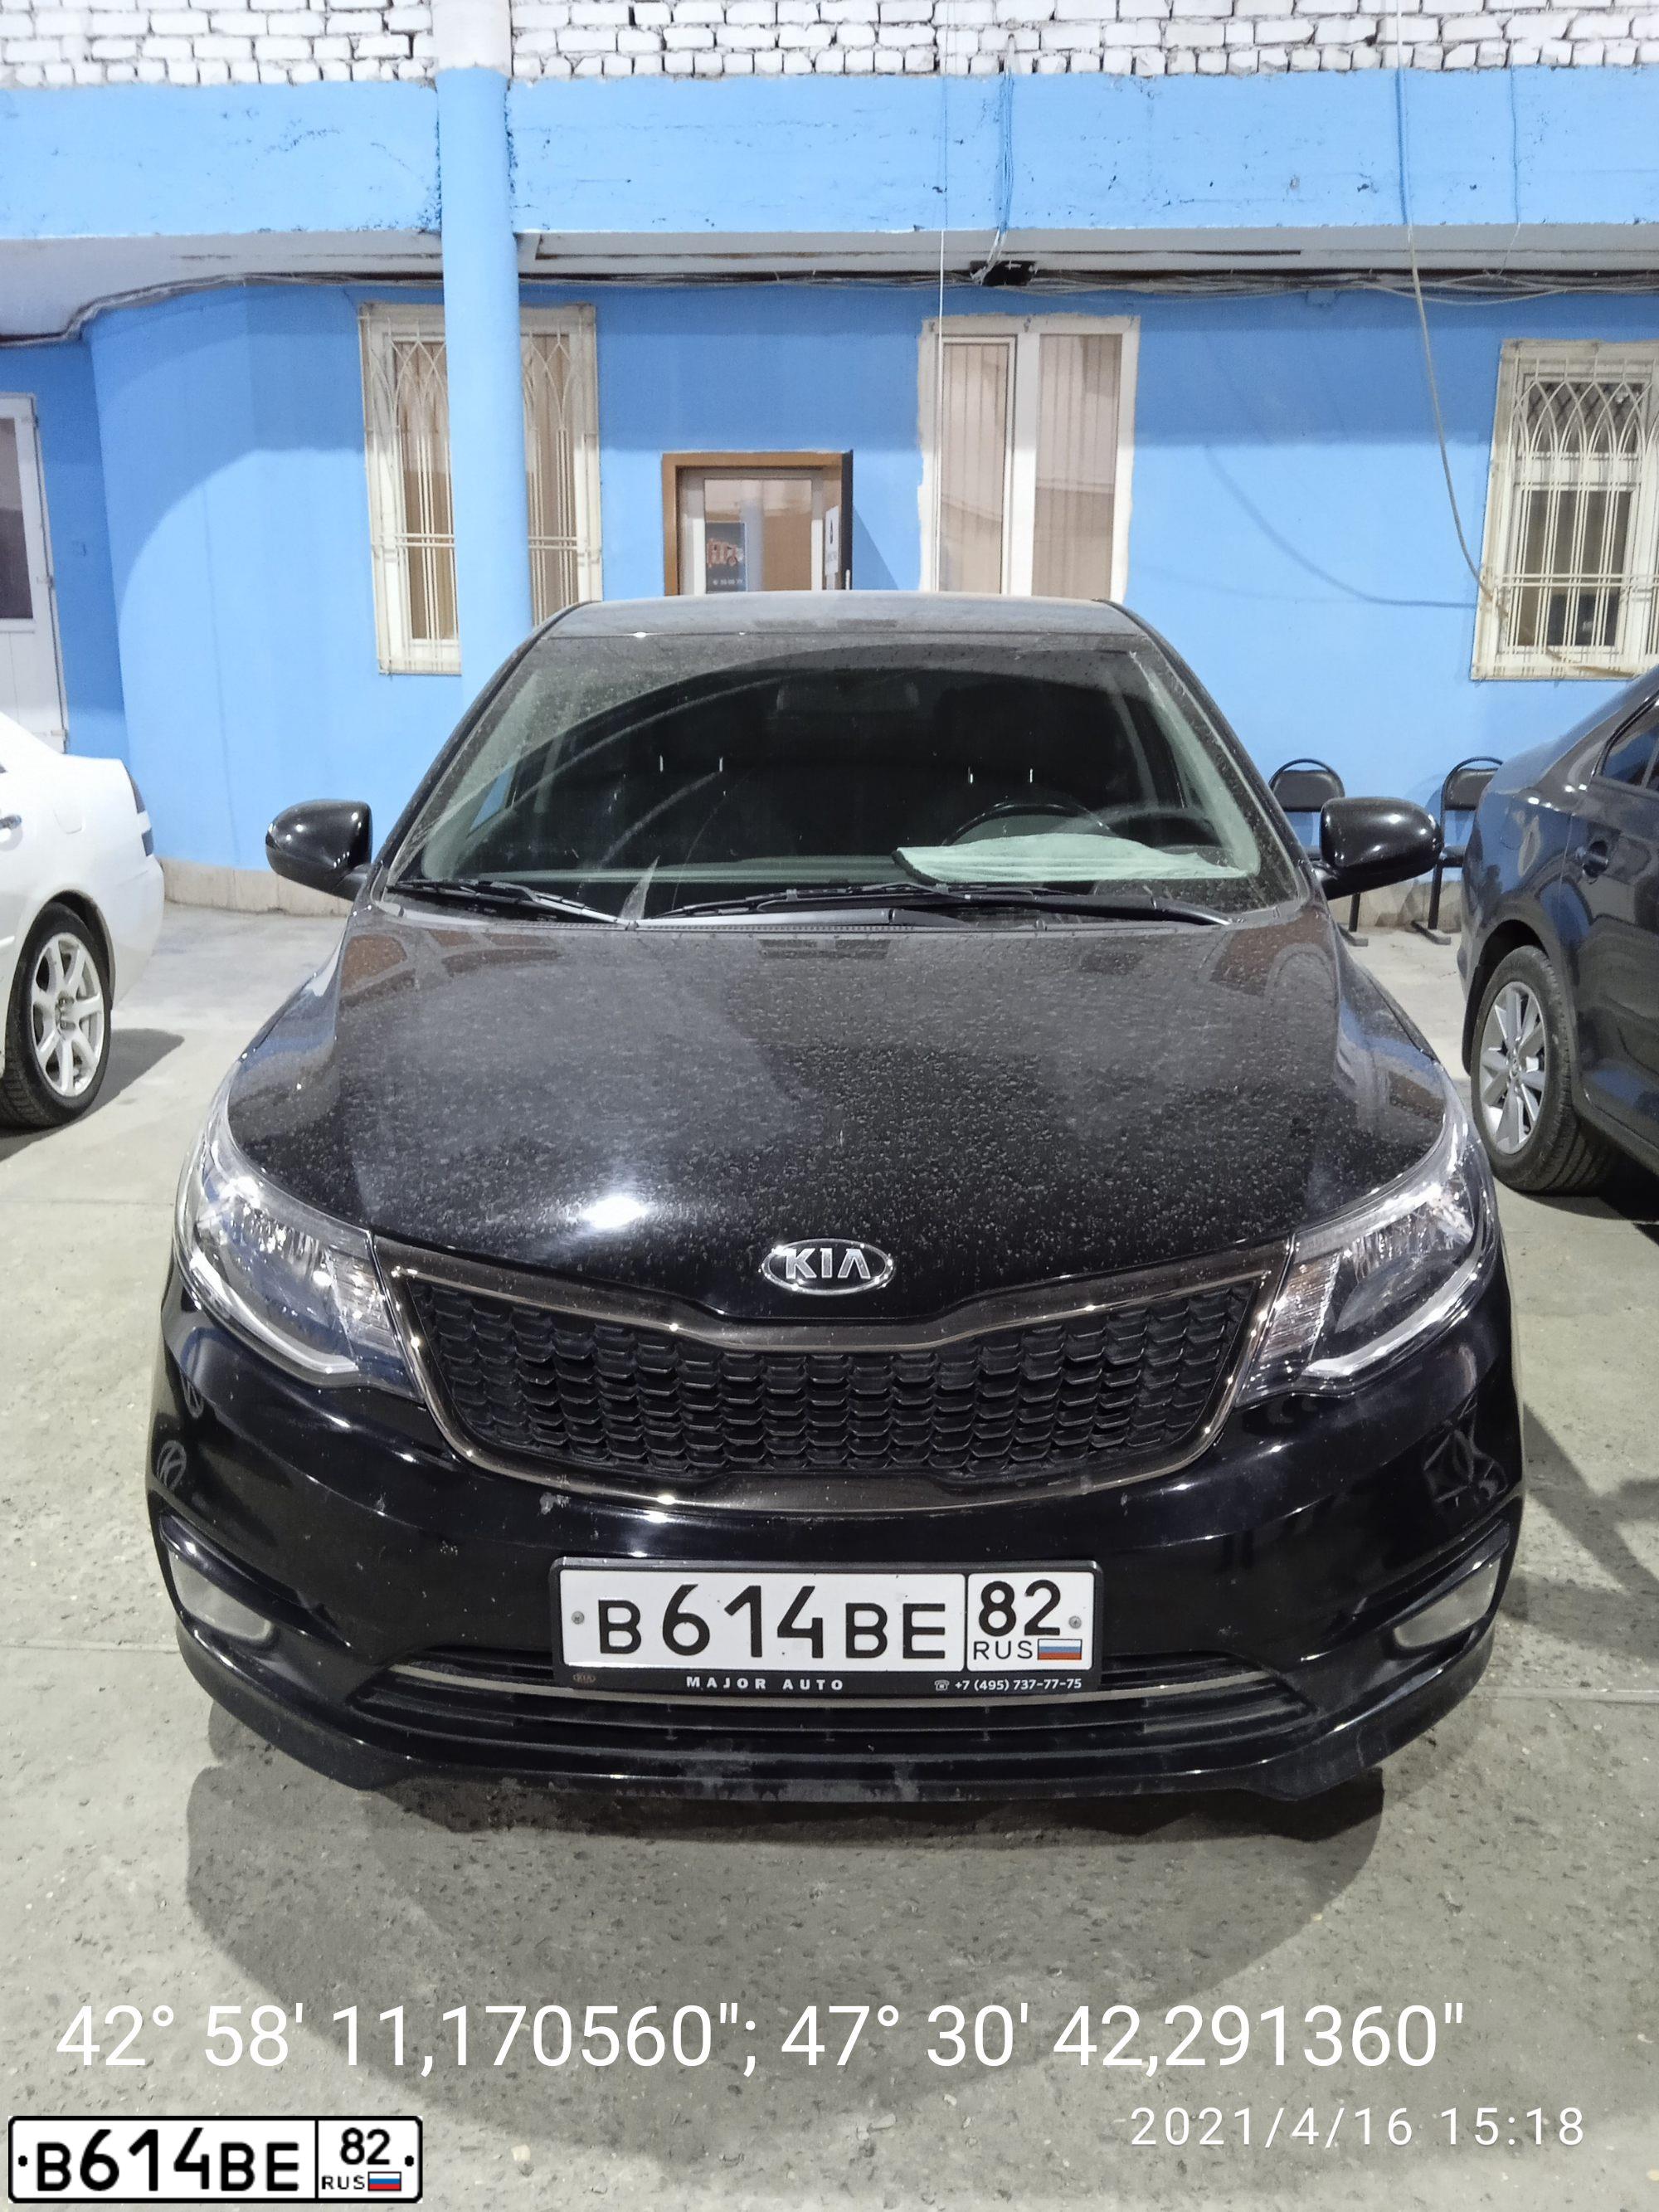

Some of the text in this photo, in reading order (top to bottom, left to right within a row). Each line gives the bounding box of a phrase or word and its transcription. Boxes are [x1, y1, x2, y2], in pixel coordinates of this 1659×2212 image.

[786, 1248, 871, 1279] KIA
[598, 1583, 946, 1659] B614BE
[978, 1580, 1062, 1637] 82
[973, 1640, 1034, 1660] RUS
[686, 1676, 844, 1690] MAJOR AUTO
[955, 1678, 1082, 1691] +7 (495) 737-77-75
